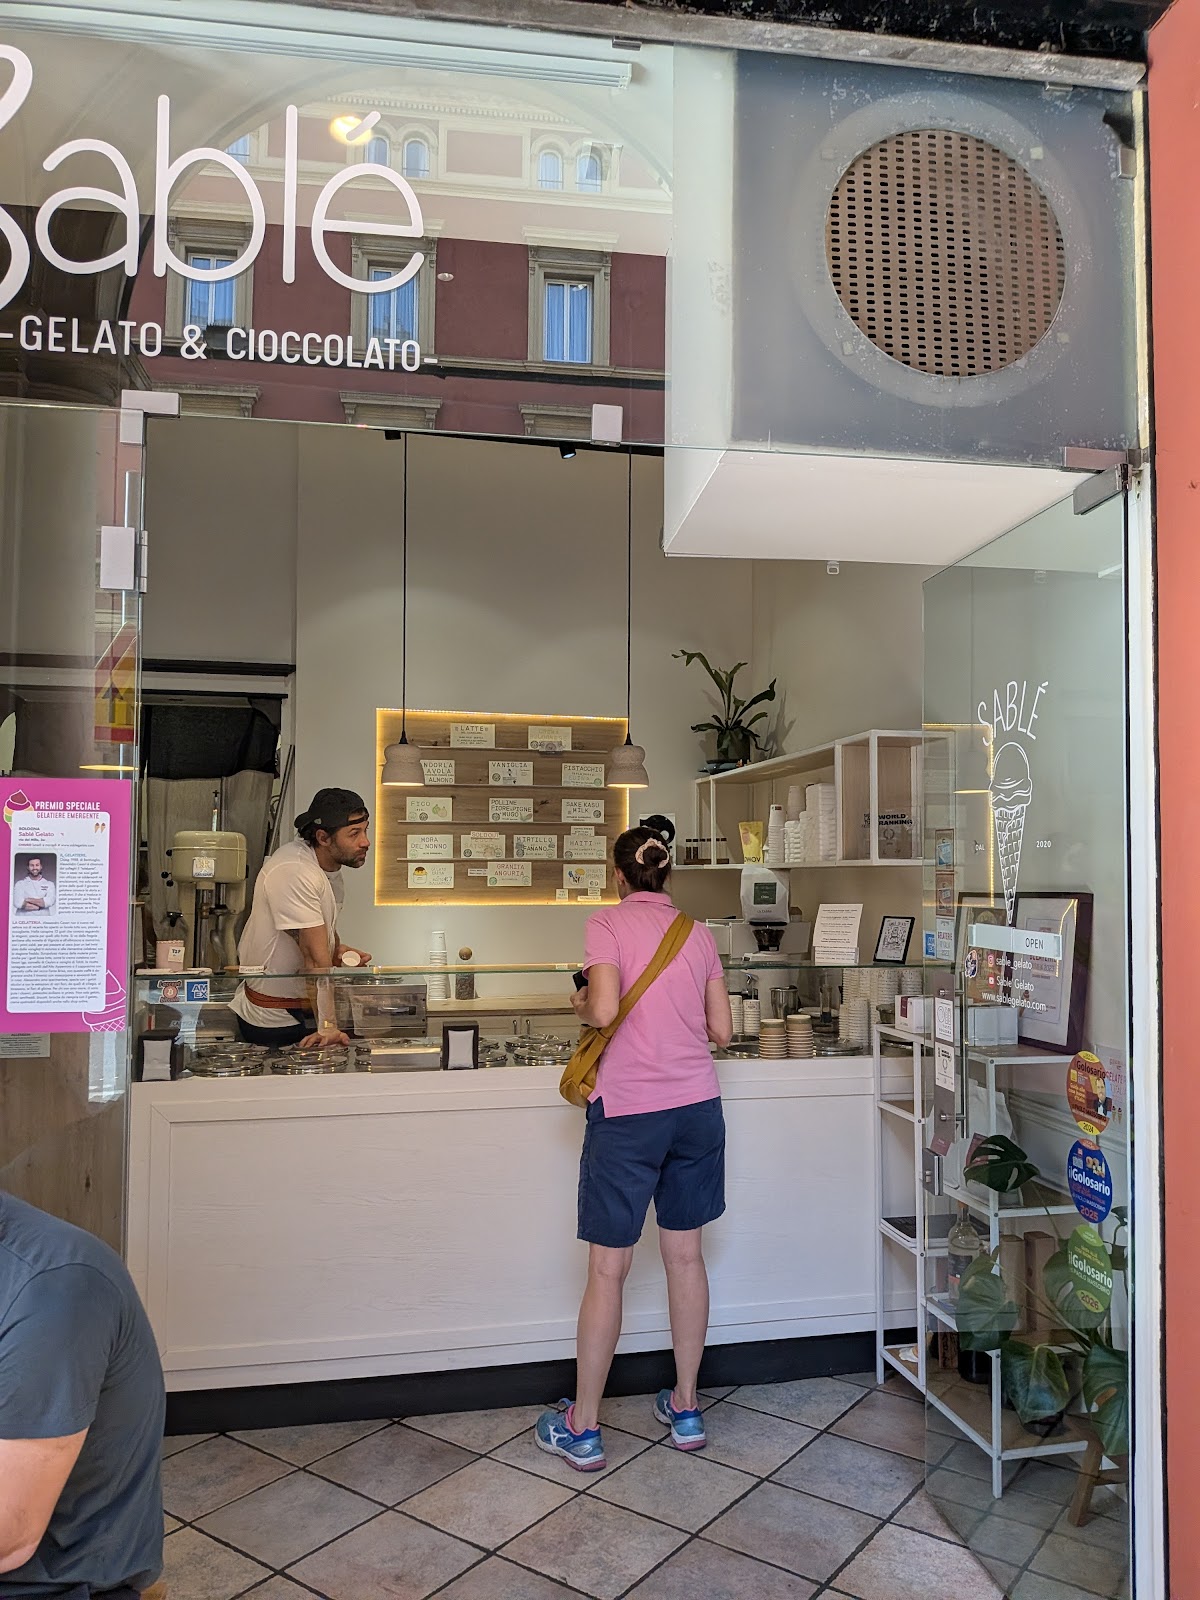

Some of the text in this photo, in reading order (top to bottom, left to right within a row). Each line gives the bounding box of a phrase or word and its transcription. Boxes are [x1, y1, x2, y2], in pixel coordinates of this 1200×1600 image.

[180, 325, 208, 360] &
[977, 680, 1049, 747] SABLÉ
[563, 764, 603, 773] PISTACCHIO
[35, 801, 101, 811] PREMIO SPECIALE
[1036, 840, 1052, 848] 2020
[1025, 937, 1044, 950] OPEN
[996, 955, 1033, 970] sable_gelato
[1014, 978, 1035, 991] Gelato
[194, 991, 208, 999] EX
[981, 991, 1047, 1012] www.sablegelato.com
[1076, 1060, 1106, 1079] Golosario
[1083, 1123, 1094, 1134] 2024
[1080, 1205, 1099, 1221] 2025
[1080, 1292, 1099, 1311] 2026
